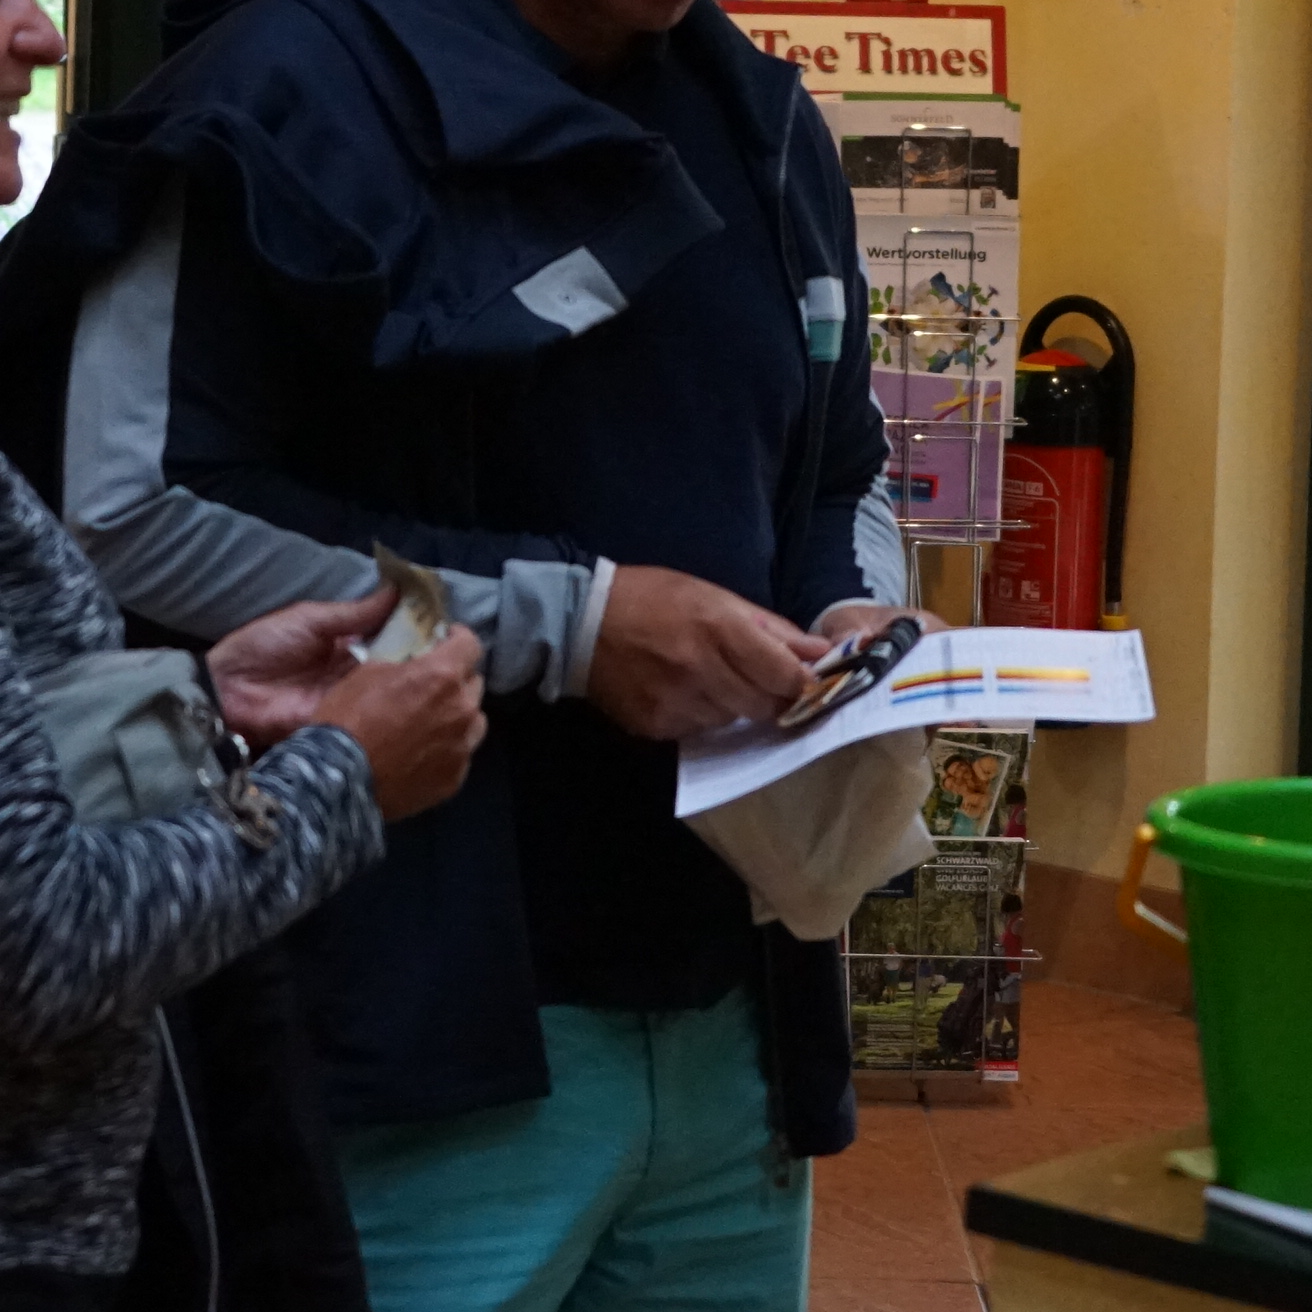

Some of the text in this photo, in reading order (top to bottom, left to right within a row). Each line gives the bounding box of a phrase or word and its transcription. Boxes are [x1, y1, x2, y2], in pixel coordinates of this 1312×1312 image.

[750, 29, 989, 77] Tee Times
[866, 246, 987, 263] Wertvorstellung
[935, 856, 999, 865] SCHWARZWALD
